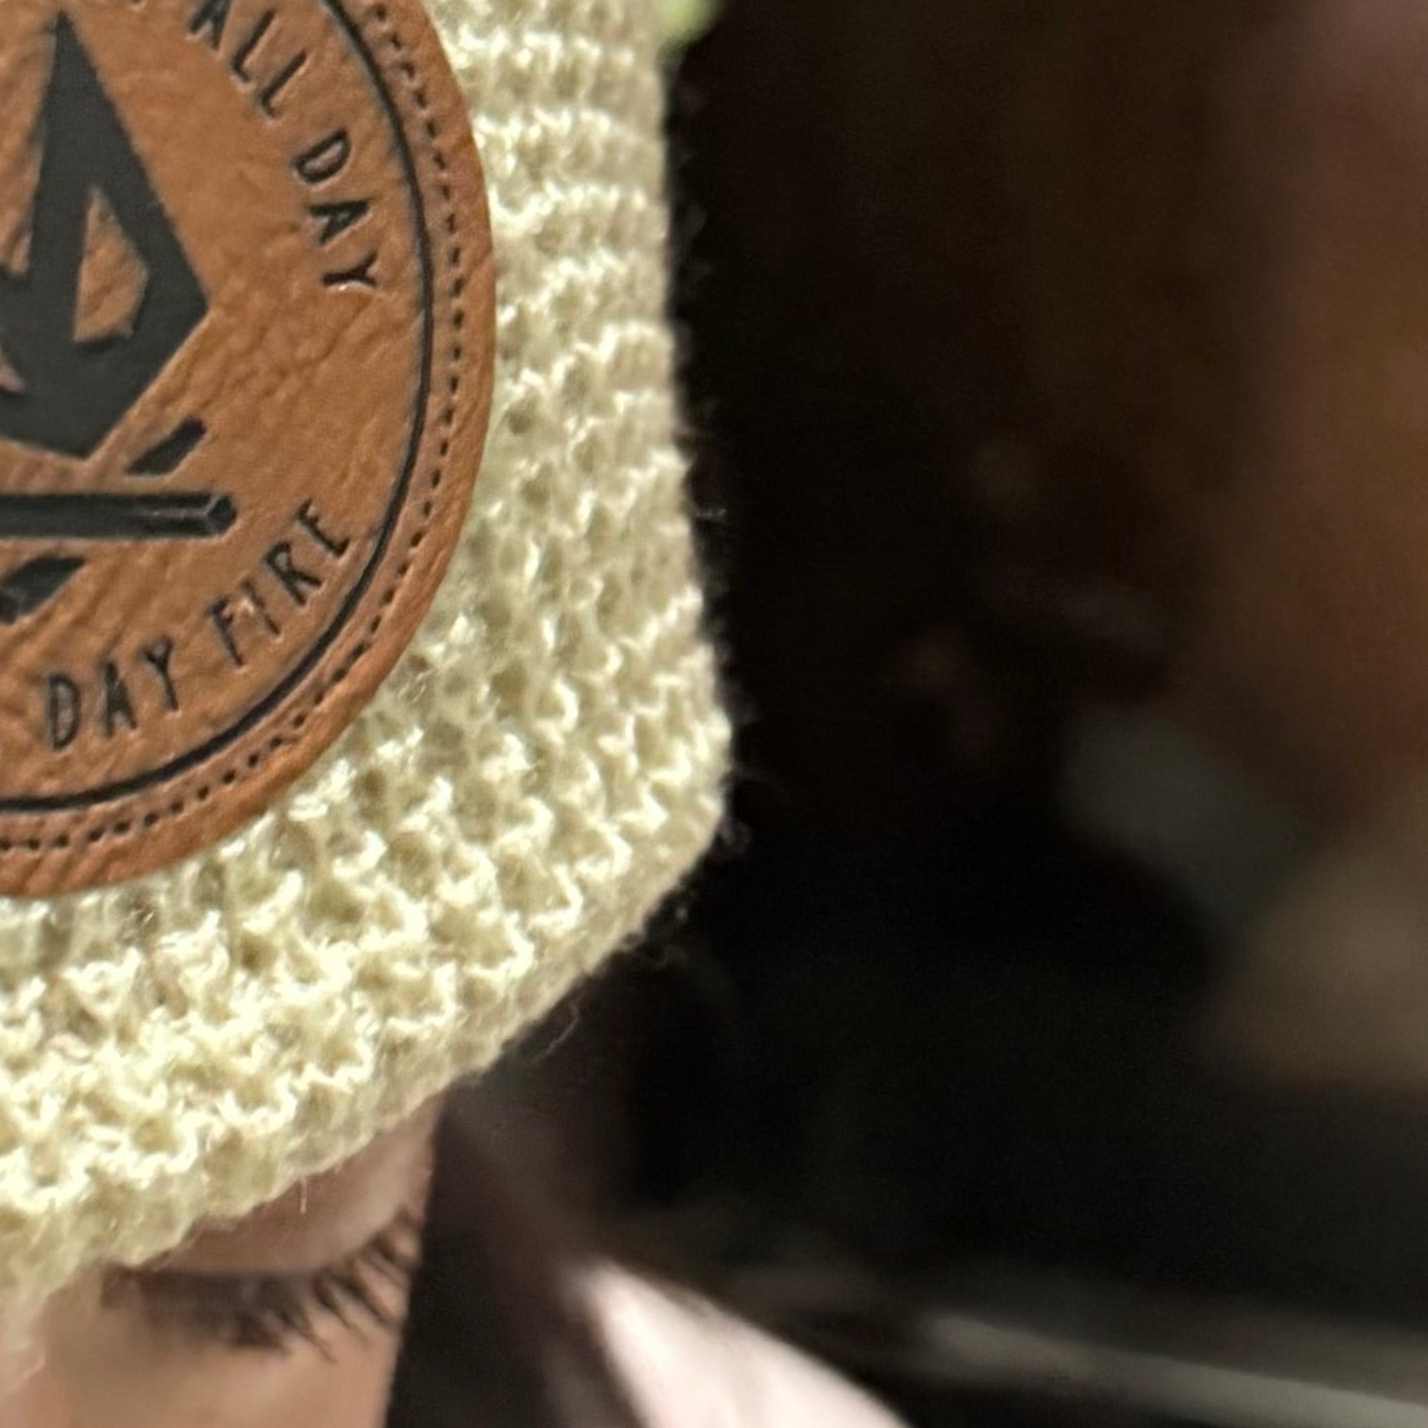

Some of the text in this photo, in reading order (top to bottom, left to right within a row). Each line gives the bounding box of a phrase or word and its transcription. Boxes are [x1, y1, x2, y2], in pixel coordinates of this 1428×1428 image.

[291, 128, 379, 288] DAY
[46, 636, 179, 752] DAY
[206, 498, 351, 667] FIRE
